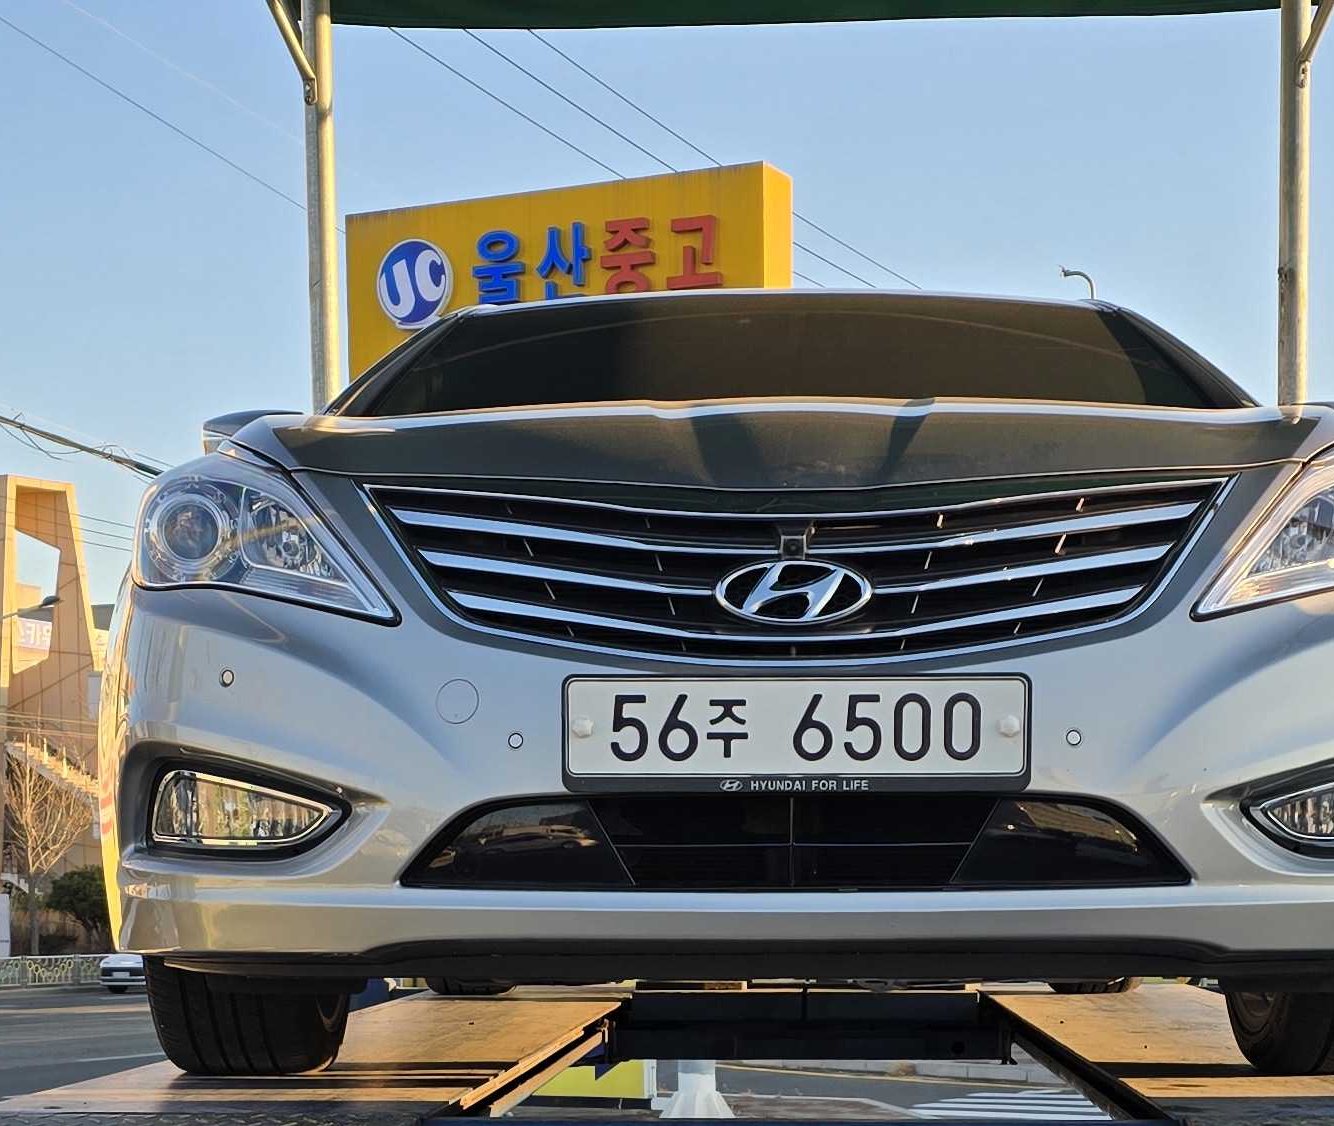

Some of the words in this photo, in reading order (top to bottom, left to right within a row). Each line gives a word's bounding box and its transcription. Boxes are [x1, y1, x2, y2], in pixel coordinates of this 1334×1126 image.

[380, 249, 446, 310] UC
[610, 694, 749, 761] 56주
[793, 693, 981, 761] 6500
[750, 780, 805, 790] HYUNDAI
[812, 780, 837, 790] FOR
[843, 780, 869, 790] LIFE
